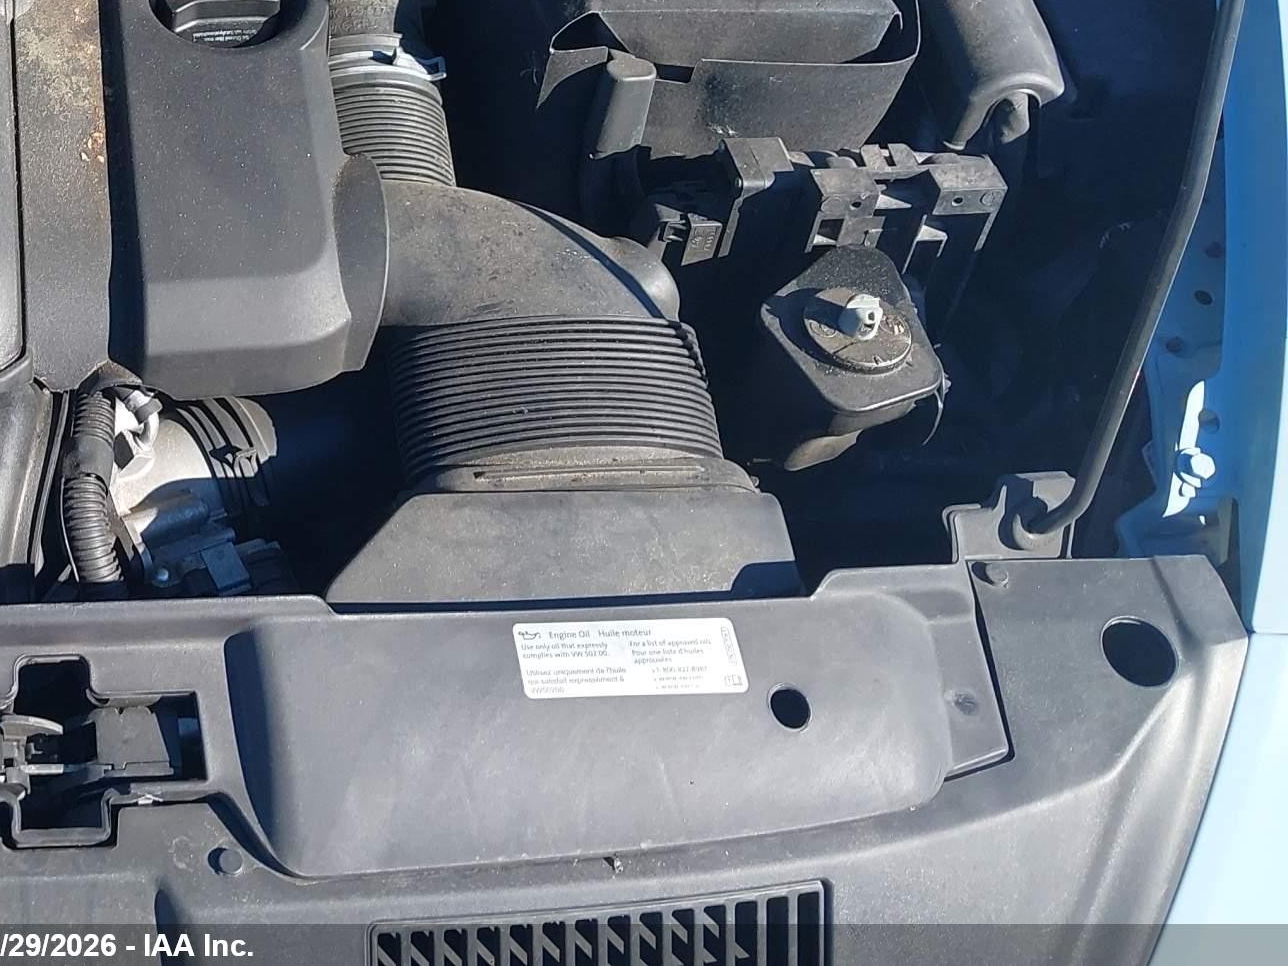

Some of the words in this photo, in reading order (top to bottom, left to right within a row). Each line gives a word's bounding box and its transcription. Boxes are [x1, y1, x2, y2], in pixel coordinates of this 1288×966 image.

[549, 631, 576, 641] Engine
[579, 630, 590, 638] Oil
[598, 629, 620, 637] Huile
[622, 628, 652, 637] moteur
